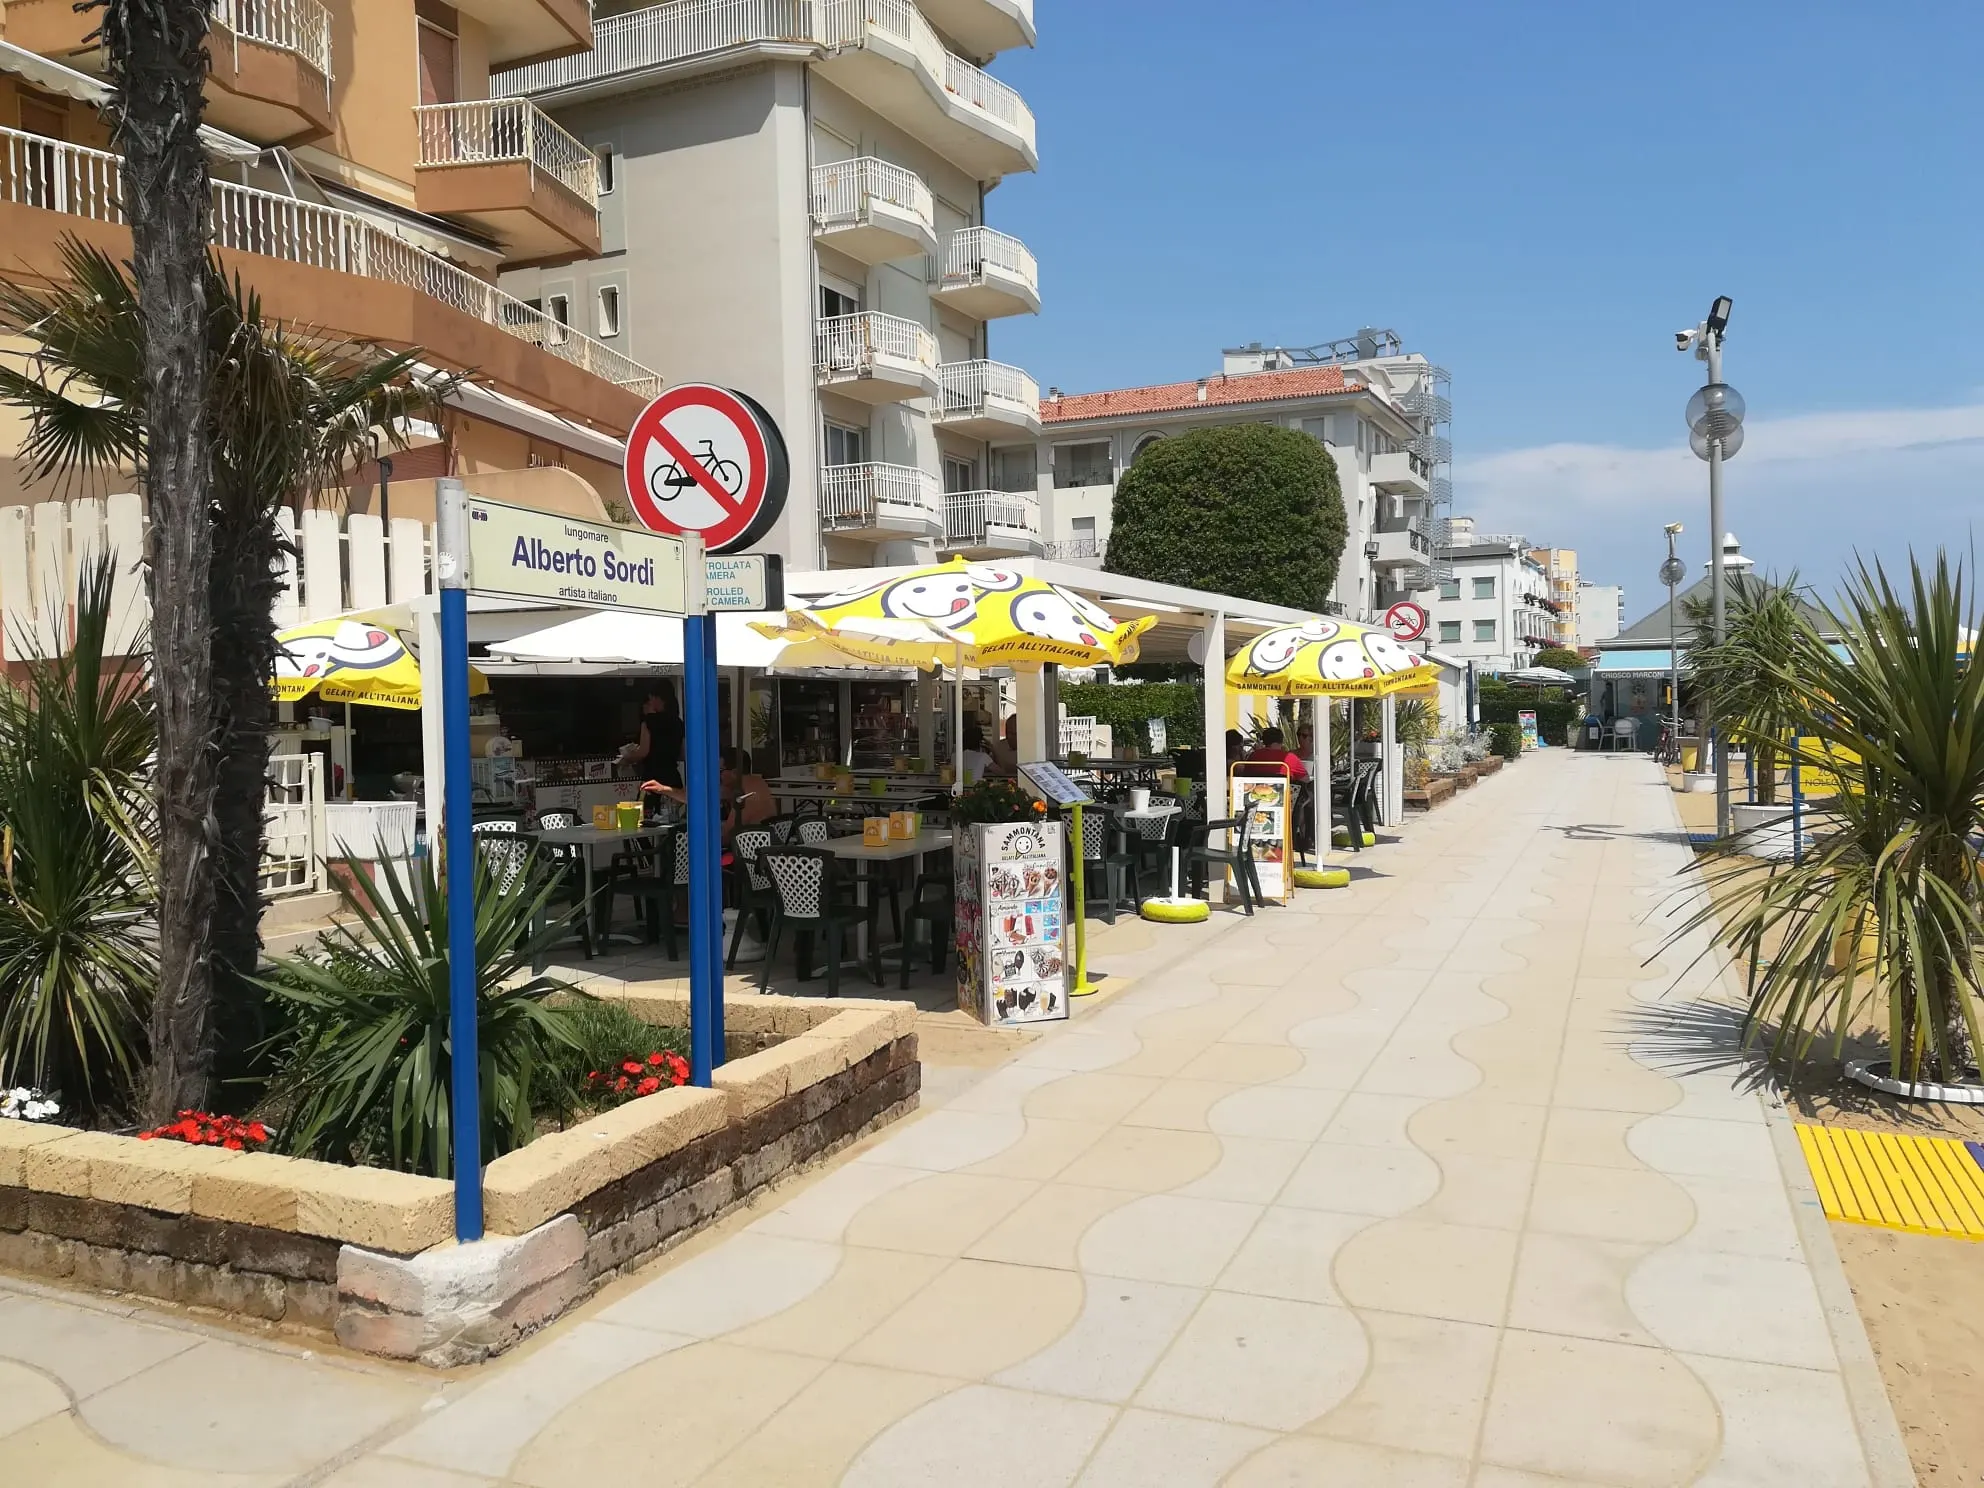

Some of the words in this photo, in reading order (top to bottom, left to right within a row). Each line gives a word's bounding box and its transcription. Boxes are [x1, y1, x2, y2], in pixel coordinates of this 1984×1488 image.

[564, 524, 609, 543] lungomare
[511, 535, 597, 578] Alberto
[603, 550, 654, 586] Sordi
[559, 586, 586, 599] artista
[588, 588, 618, 603] italiano
[711, 596, 751, 606] CAMERA
[982, 641, 1015, 655] GELATI
[1017, 641, 1091, 660] ALL'ITALIANA
[1632, 671, 1664, 679] MARCONI
[1237, 683, 1282, 691] SAMMONTANA
[1322, 682, 1374, 690] ALL'ITALIANA
[325, 688, 355, 698] GELATI
[357, 692, 420, 706] ALL'ITALIANA
[1001, 826, 1046, 852] SAMMONTANA
